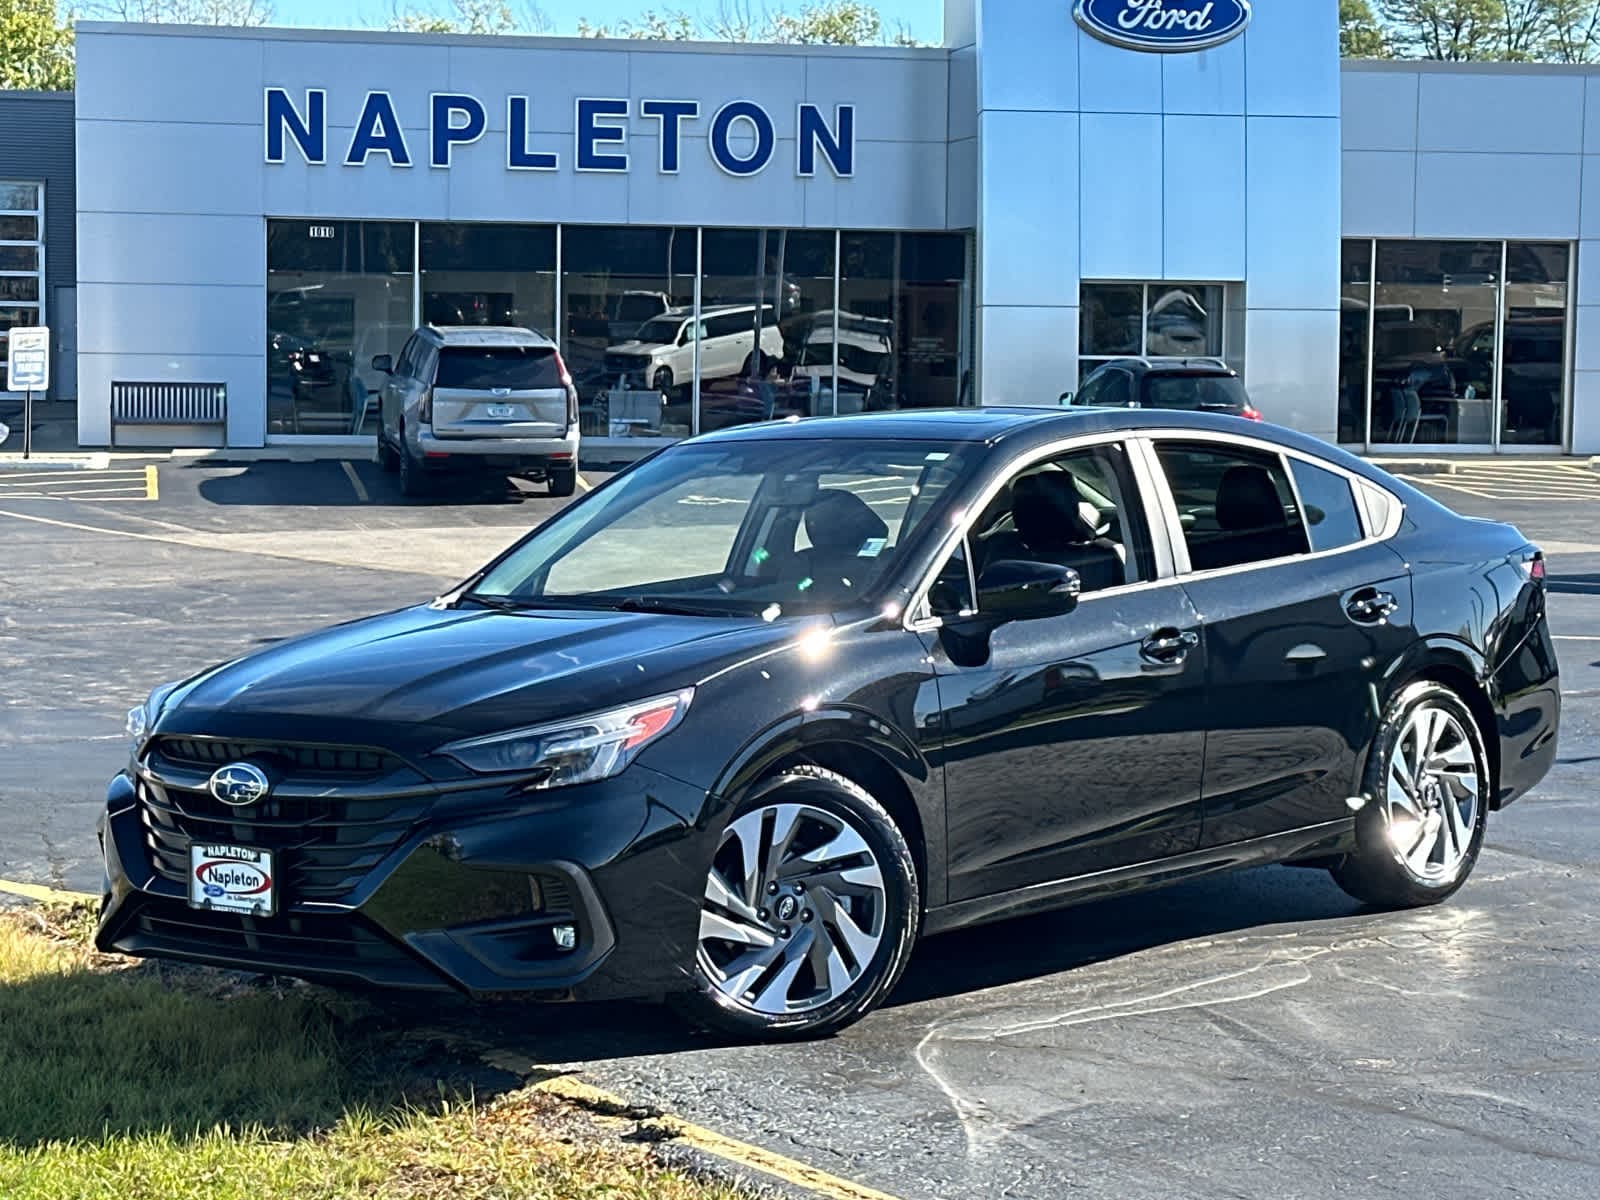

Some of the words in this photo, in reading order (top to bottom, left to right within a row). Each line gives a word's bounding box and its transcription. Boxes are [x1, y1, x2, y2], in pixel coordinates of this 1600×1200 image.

[1118, 0, 1212, 30] Ford
[264, 87, 856, 177] NAPLETON
[310, 226, 335, 238] 1010
[207, 845, 256, 860] NAPLETON
[208, 865, 259, 888] Napleton
